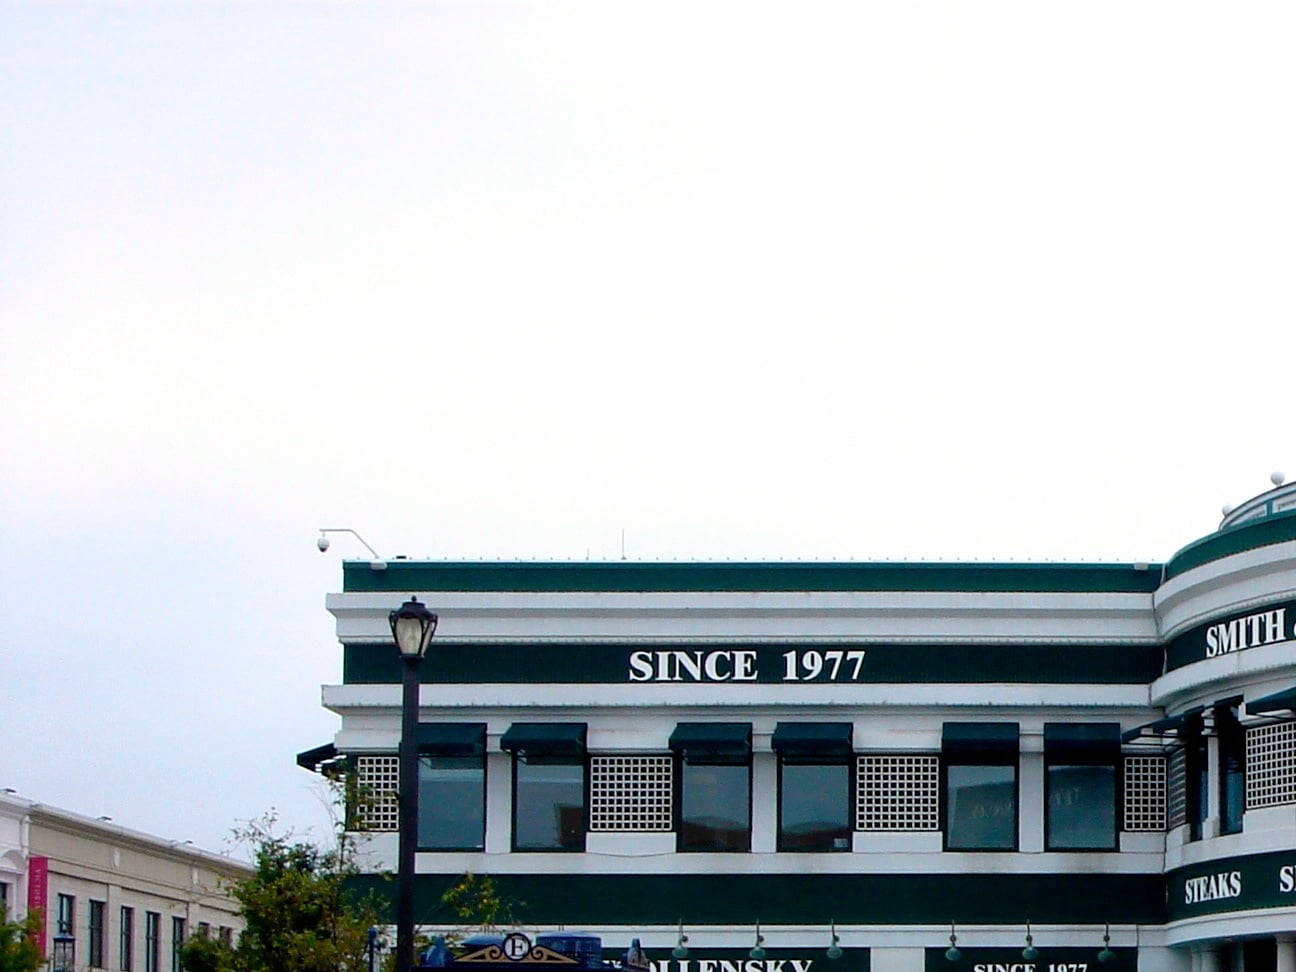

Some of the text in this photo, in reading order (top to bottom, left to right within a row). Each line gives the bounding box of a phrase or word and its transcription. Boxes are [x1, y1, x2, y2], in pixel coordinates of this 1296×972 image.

[1205, 607, 1287, 659] SMITH
[629, 650, 866, 681] SINCE 1977
[1184, 870, 1242, 905] STEAKS
[510, 937, 524, 957] E
